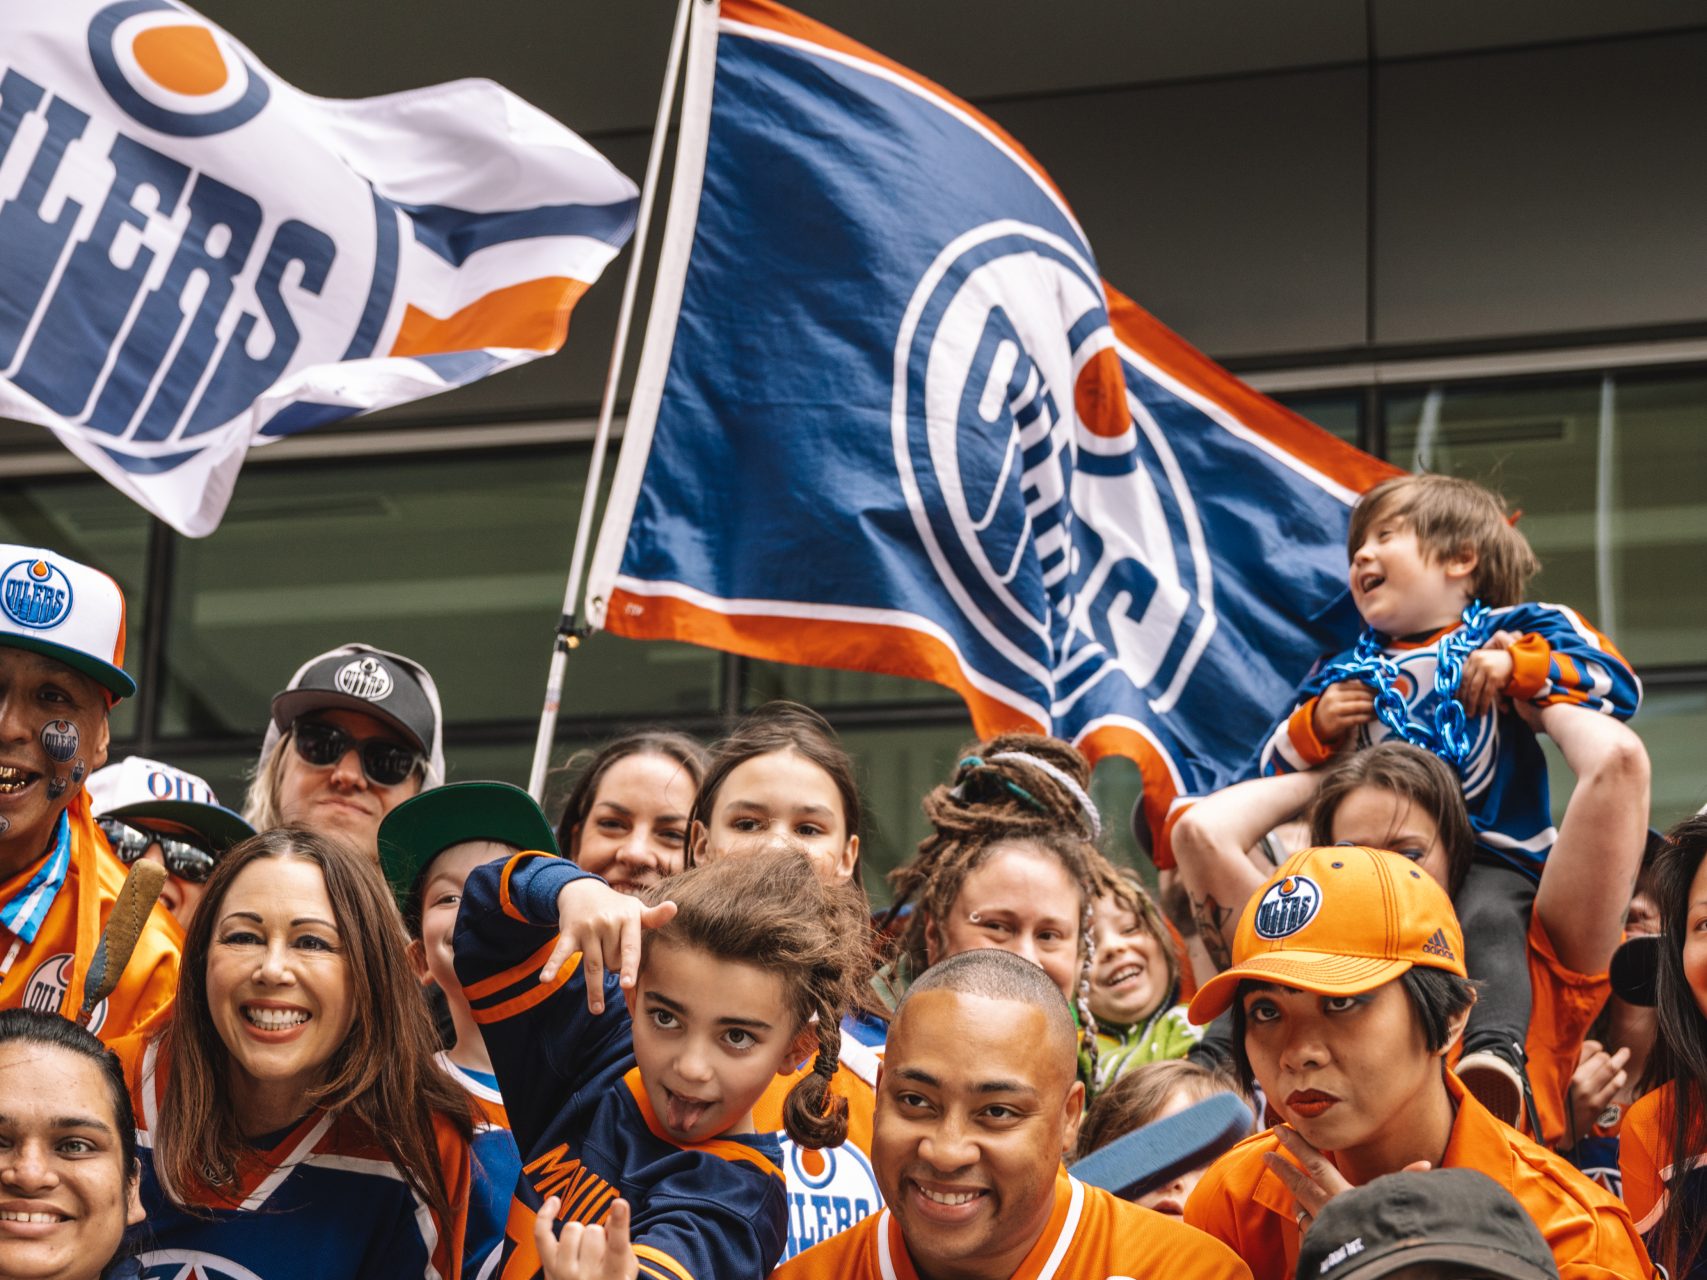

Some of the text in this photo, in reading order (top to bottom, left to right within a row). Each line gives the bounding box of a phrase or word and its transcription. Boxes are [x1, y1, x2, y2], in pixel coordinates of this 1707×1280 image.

[0, 66, 337, 441] ILERS
[5, 578, 66, 624] OILERS
[44, 733, 77, 762] OILERS
[1259, 895, 1312, 935] OILERS
[1422, 943, 1456, 962] adidas
[779, 1191, 870, 1265] ILER
